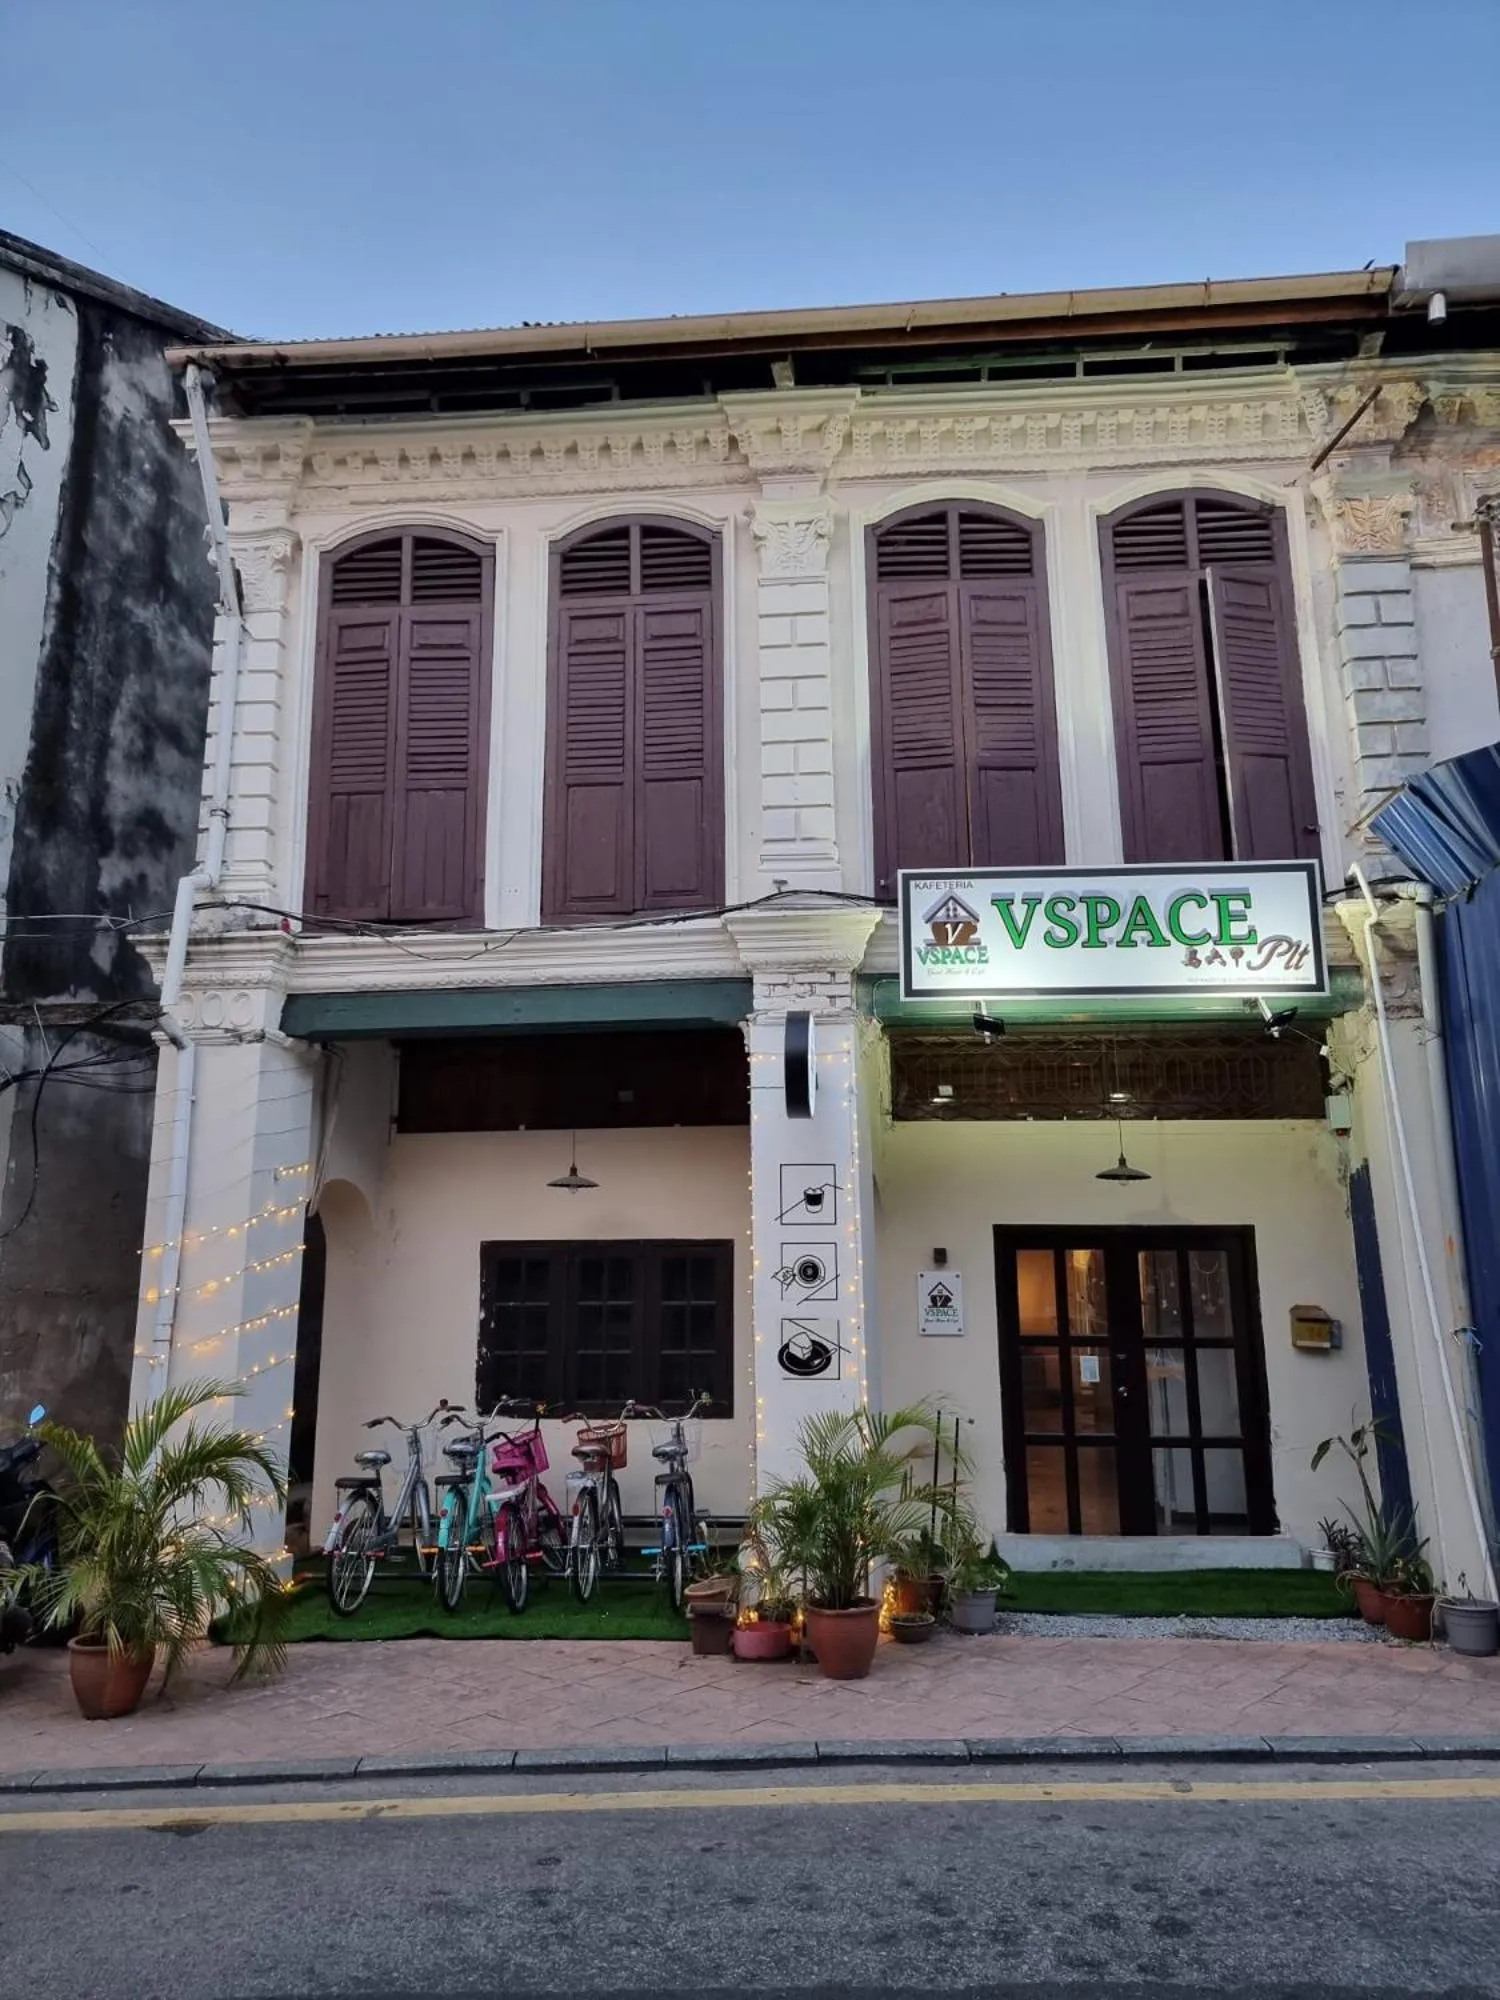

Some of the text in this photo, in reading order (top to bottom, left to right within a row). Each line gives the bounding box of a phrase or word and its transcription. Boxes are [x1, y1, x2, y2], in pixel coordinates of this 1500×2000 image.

[914, 880, 974, 890] KAFETERIA
[990, 891, 1258, 949] VSPACE
[944, 922, 964, 944] V
[914, 945, 989, 965] VSPACE
